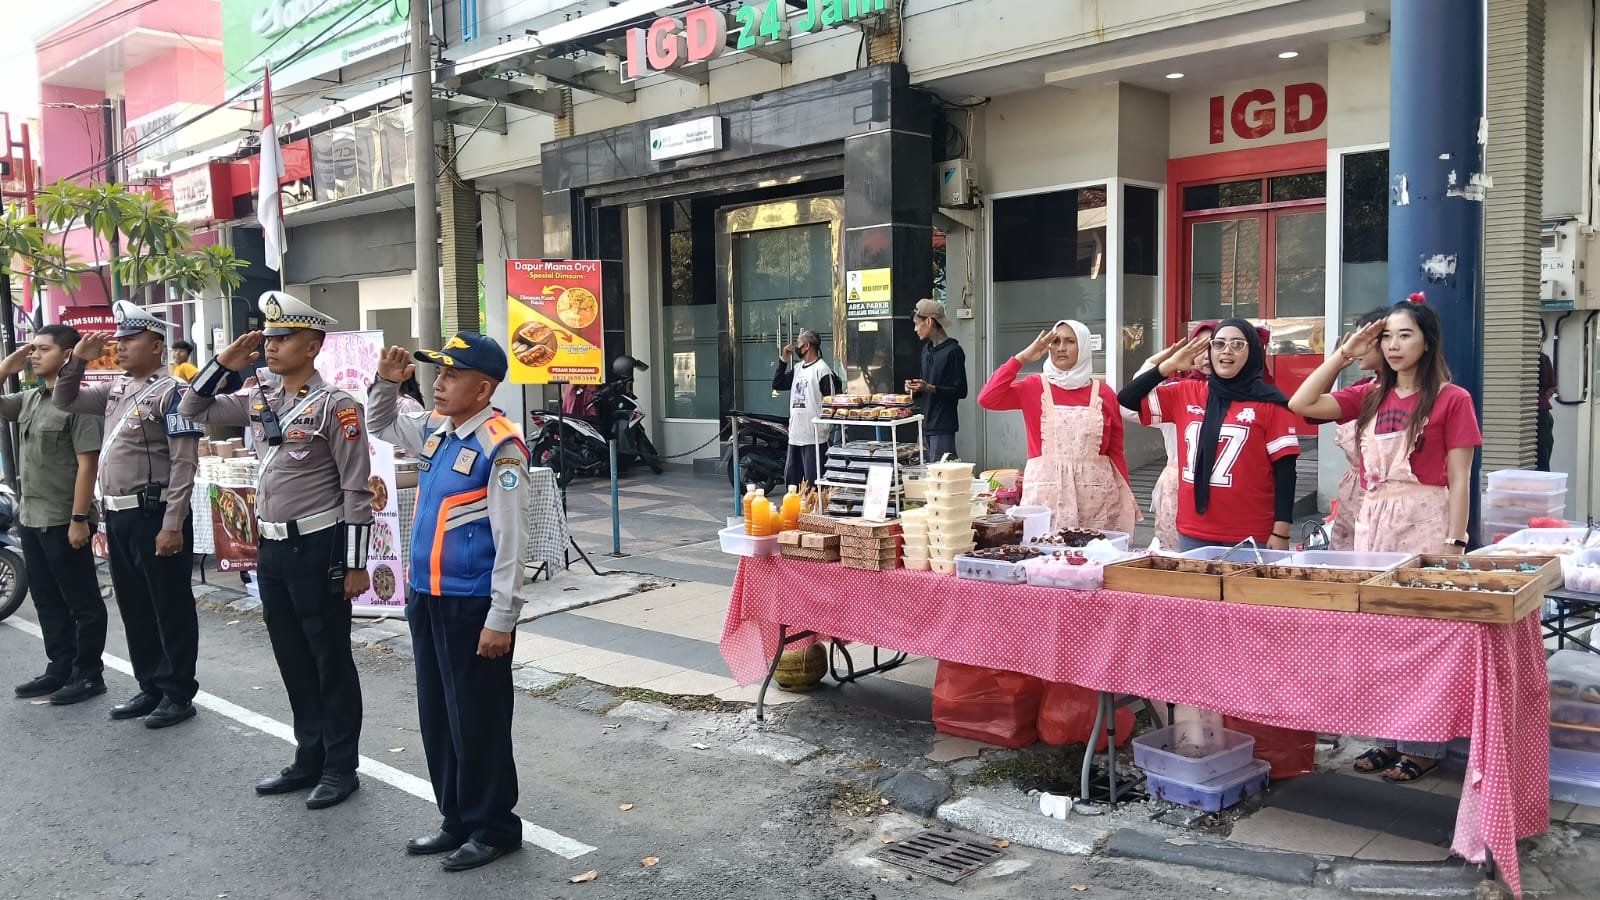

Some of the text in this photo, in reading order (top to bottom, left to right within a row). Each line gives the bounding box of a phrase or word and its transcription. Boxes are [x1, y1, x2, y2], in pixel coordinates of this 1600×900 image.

[626, 5, 725, 79] IGD
[736, 0, 786, 50] 24
[1209, 82, 1328, 145] IGD
[514, 262, 544, 271] Dapur
[545, 262, 573, 271] Mama
[1542, 262, 1564, 270] PLN
[848, 301, 889, 311] AREA PARKIR
[62, 316, 102, 326] DIMSUM
[1181, 420, 1250, 488] 17
